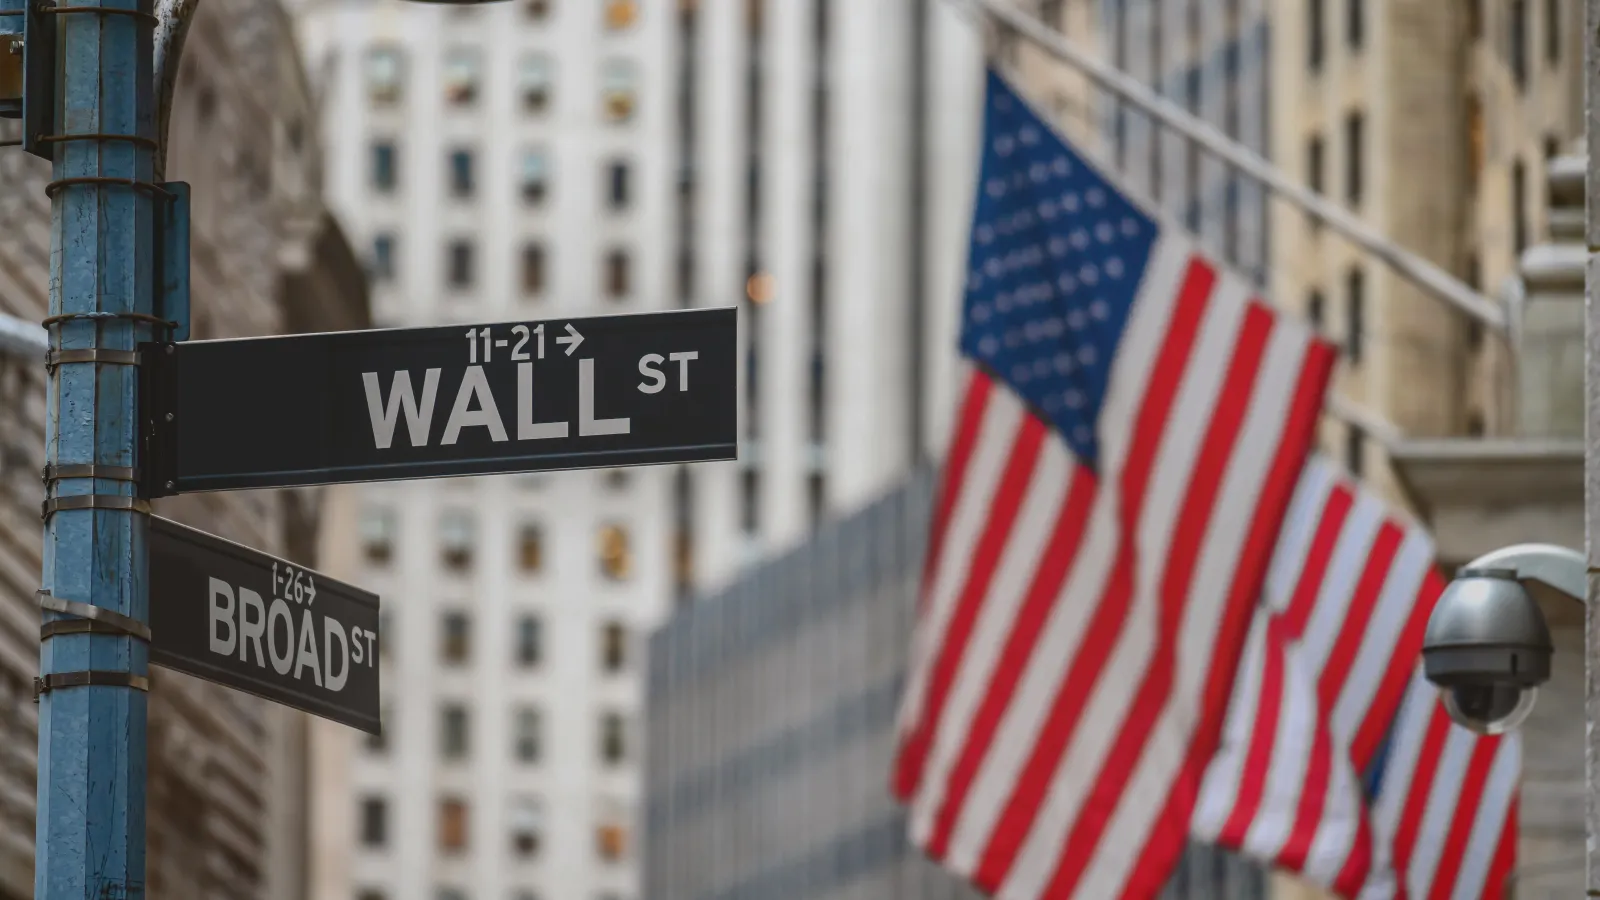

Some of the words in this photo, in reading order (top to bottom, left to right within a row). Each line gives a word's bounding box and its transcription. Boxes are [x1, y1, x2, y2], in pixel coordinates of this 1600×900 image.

[465, 324, 545, 363] 11-21
[362, 358, 631, 449] WALL
[637, 351, 698, 394] ST
[272, 562, 304, 604] 1-26
[209, 576, 349, 692] BROAD
[351, 625, 376, 668] ST
